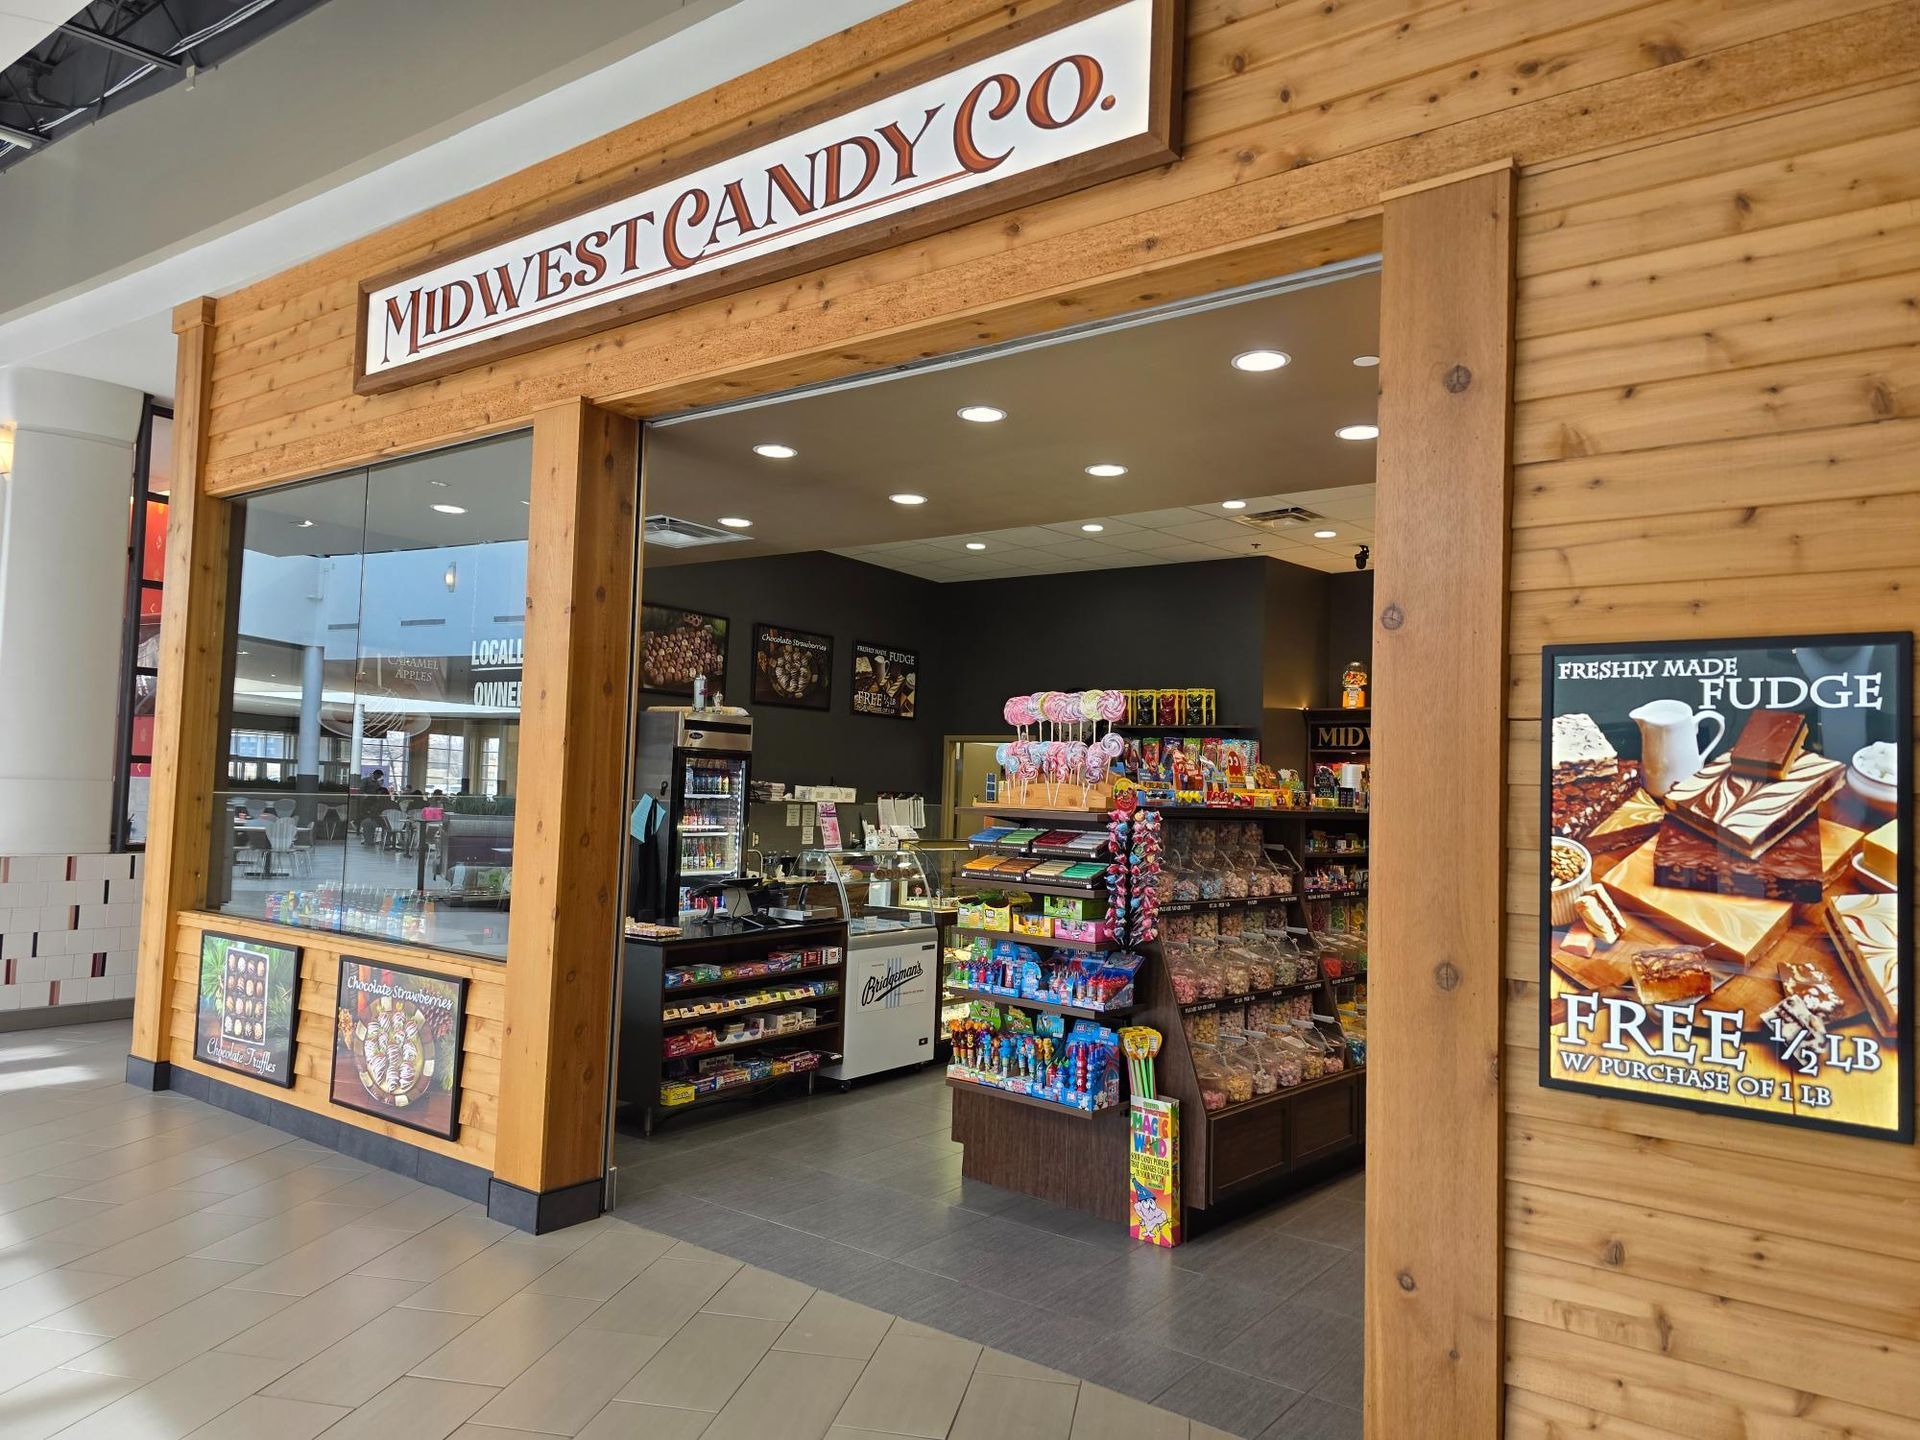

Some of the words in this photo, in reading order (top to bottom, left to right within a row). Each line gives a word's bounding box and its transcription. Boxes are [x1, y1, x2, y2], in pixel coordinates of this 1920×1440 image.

[381, 211, 656, 366] MIDWEST
[663, 103, 944, 270] CANDY
[953, 54, 1116, 174] CO.
[761, 633, 792, 646] Chocolate
[387, 656, 439, 670] CARAMEL
[889, 651, 915, 666] FUDGE
[1557, 659, 1659, 681] FRESHLY
[1663, 657, 1738, 678] MADE
[395, 669, 433, 682] APPLES
[857, 690, 883, 708] FREE
[1698, 672, 1882, 711] FUDGE
[347, 975, 392, 998] Chocolate
[392, 985, 455, 1011] Strawberries
[861, 960, 924, 1007] Bridgeman's
[1560, 992, 1746, 1072] FREE
[1825, 1032, 1882, 1072] LB
[206, 1037, 245, 1064] Chocolate
[245, 1046, 276, 1075] Truffles
[1560, 1051, 1595, 1073] W/
[1599, 1059, 1729, 1095] PURCHASE
[1739, 1076, 1774, 1098] OF
[1800, 1084, 1832, 1107] LB
[1132, 1112, 1169, 1139] MAGIC
[1134, 1132, 1167, 1159] WAND
